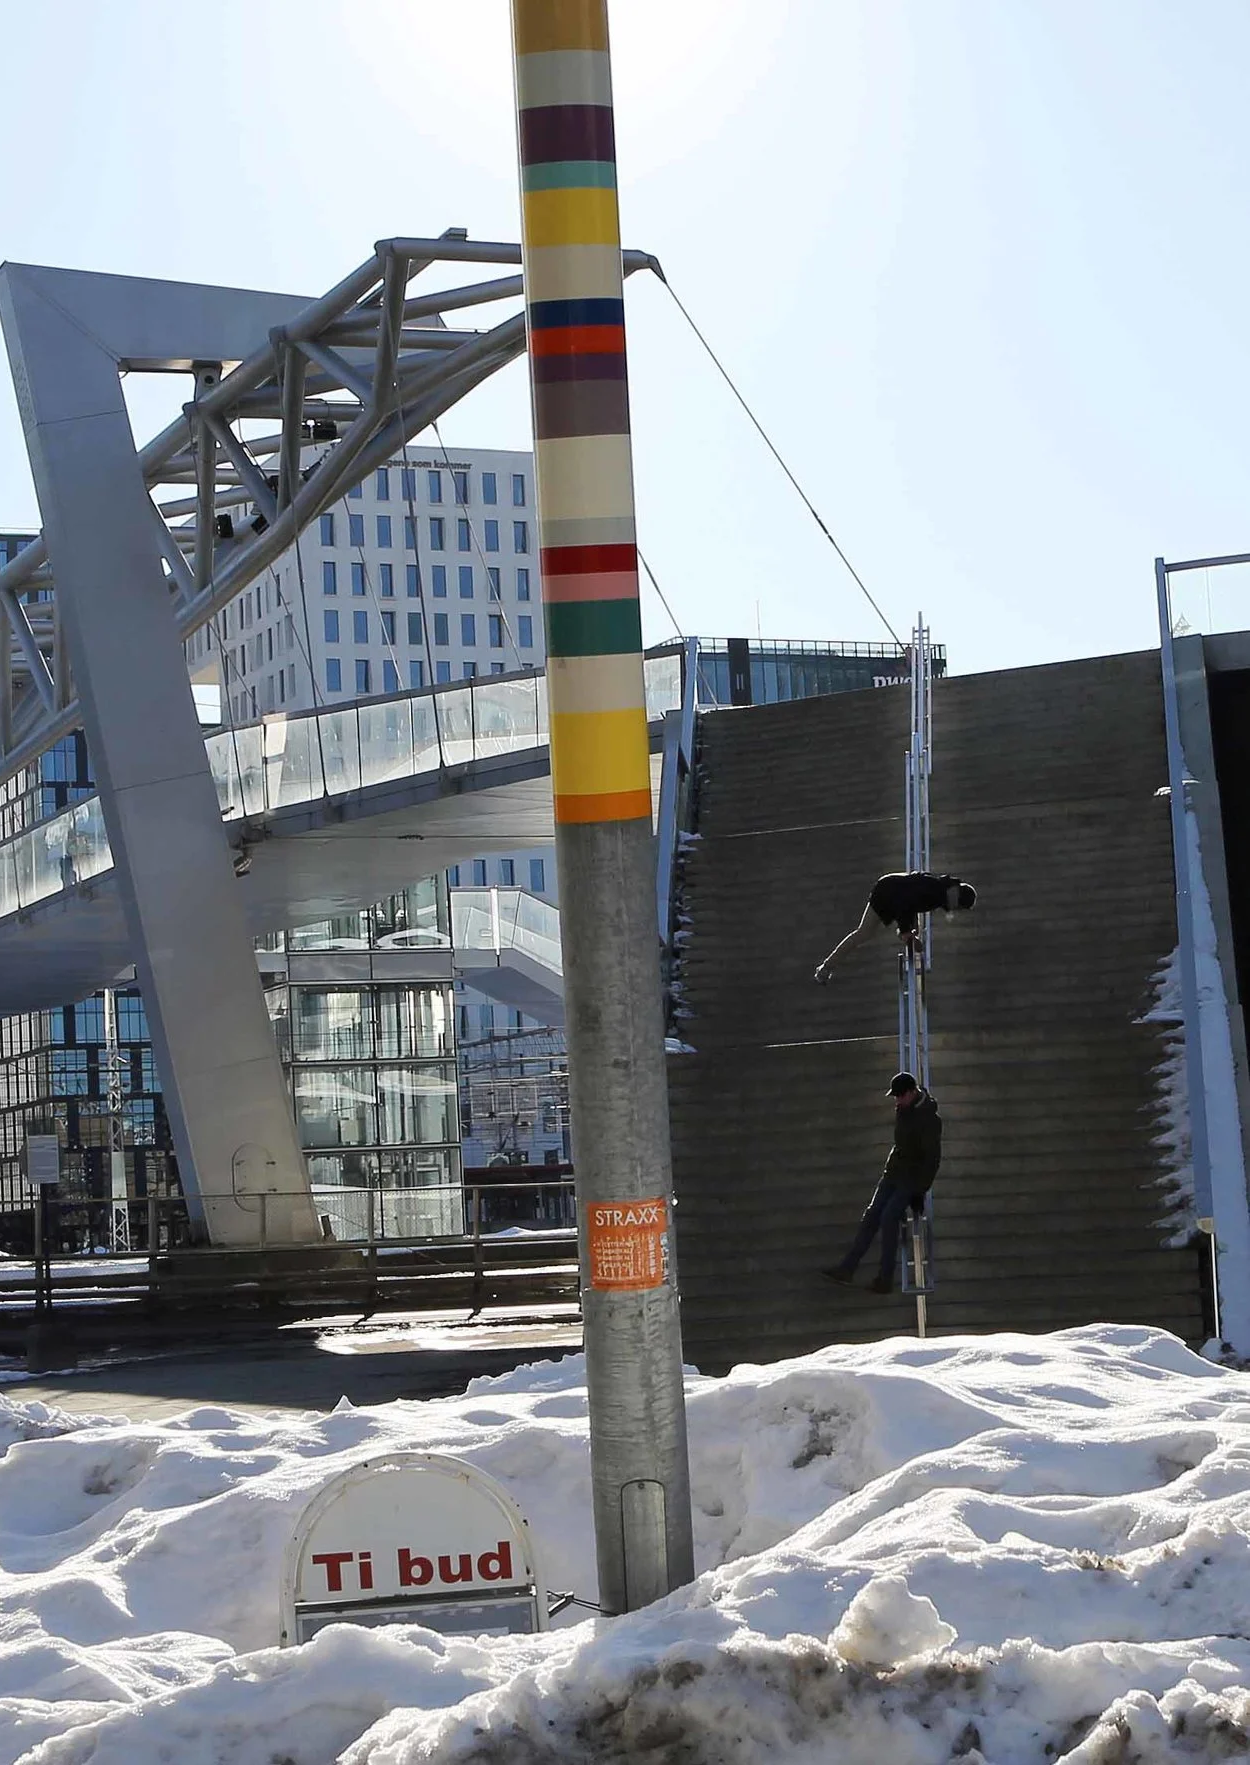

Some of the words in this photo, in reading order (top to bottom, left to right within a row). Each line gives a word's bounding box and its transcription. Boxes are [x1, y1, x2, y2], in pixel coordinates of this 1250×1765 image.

[412, 460, 432, 468] som
[434, 459, 472, 470] kommer
[595, 1206, 659, 1226] STRAXX
[312, 1551, 374, 1592] Ti
[397, 1541, 514, 1587] bud
